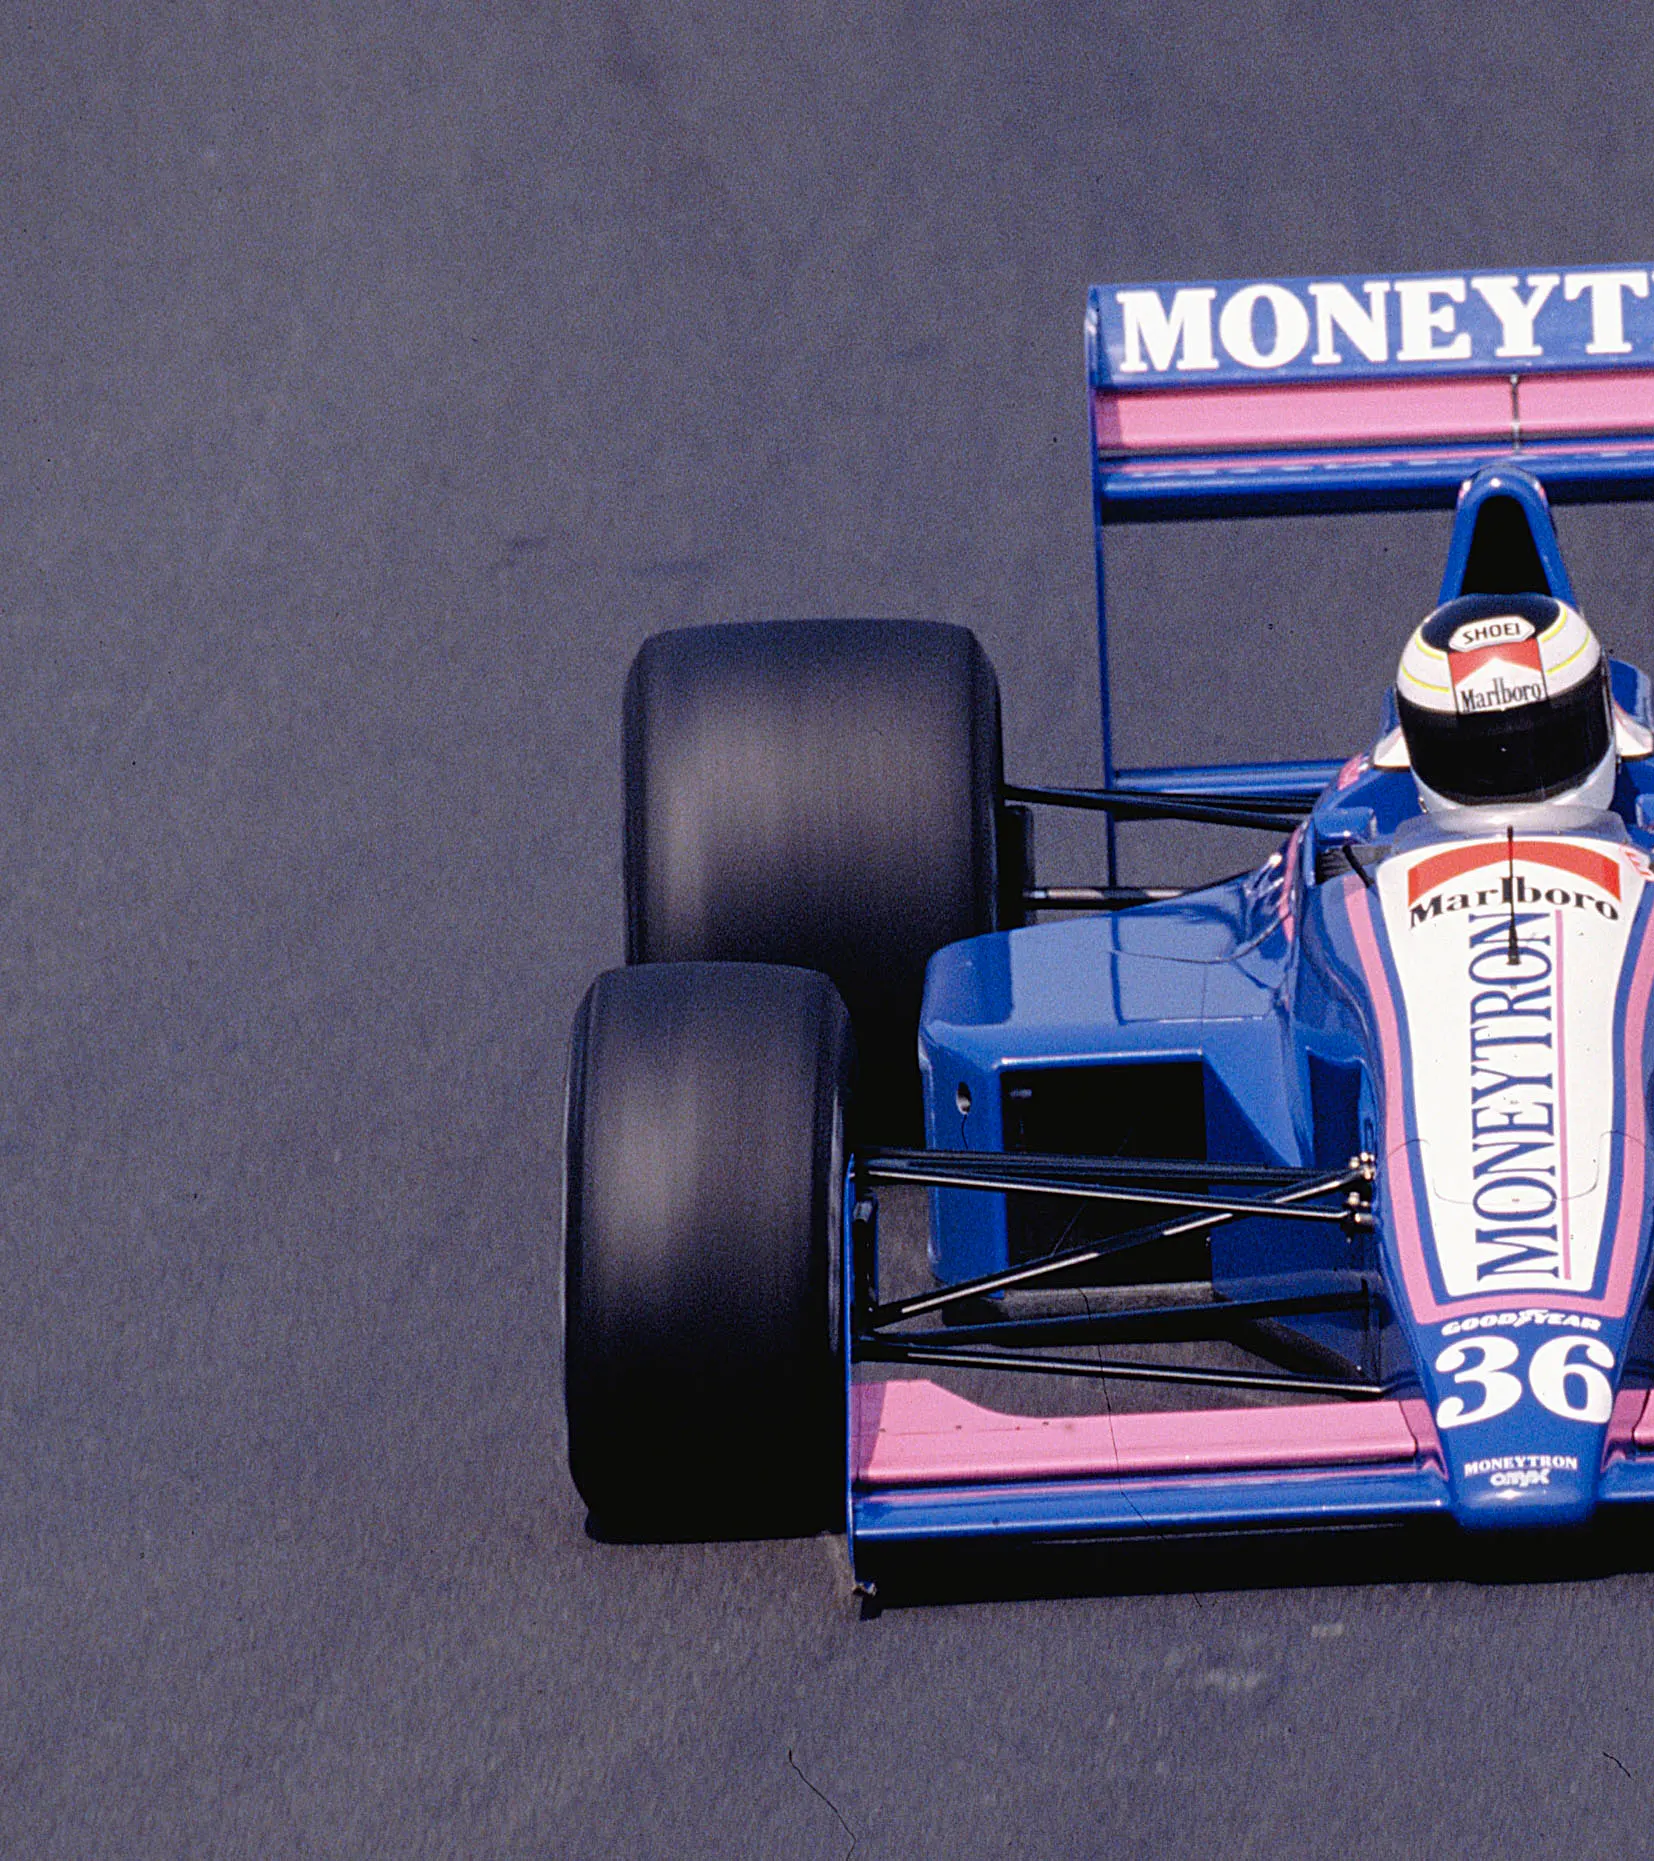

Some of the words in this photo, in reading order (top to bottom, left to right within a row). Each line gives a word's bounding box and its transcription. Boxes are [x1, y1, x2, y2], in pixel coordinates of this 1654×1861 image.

[1461, 622, 1521, 645] SHOEI
[1460, 677, 1543, 712] Marlboro
[1409, 876, 1619, 928] Marlboro
[1468, 912, 1560, 1282] MONEYTRON
[1441, 1309, 1601, 1336] GOODYEAR
[1435, 1335, 1615, 1429] 36
[1464, 1455, 1578, 1477] MONEYTRON
